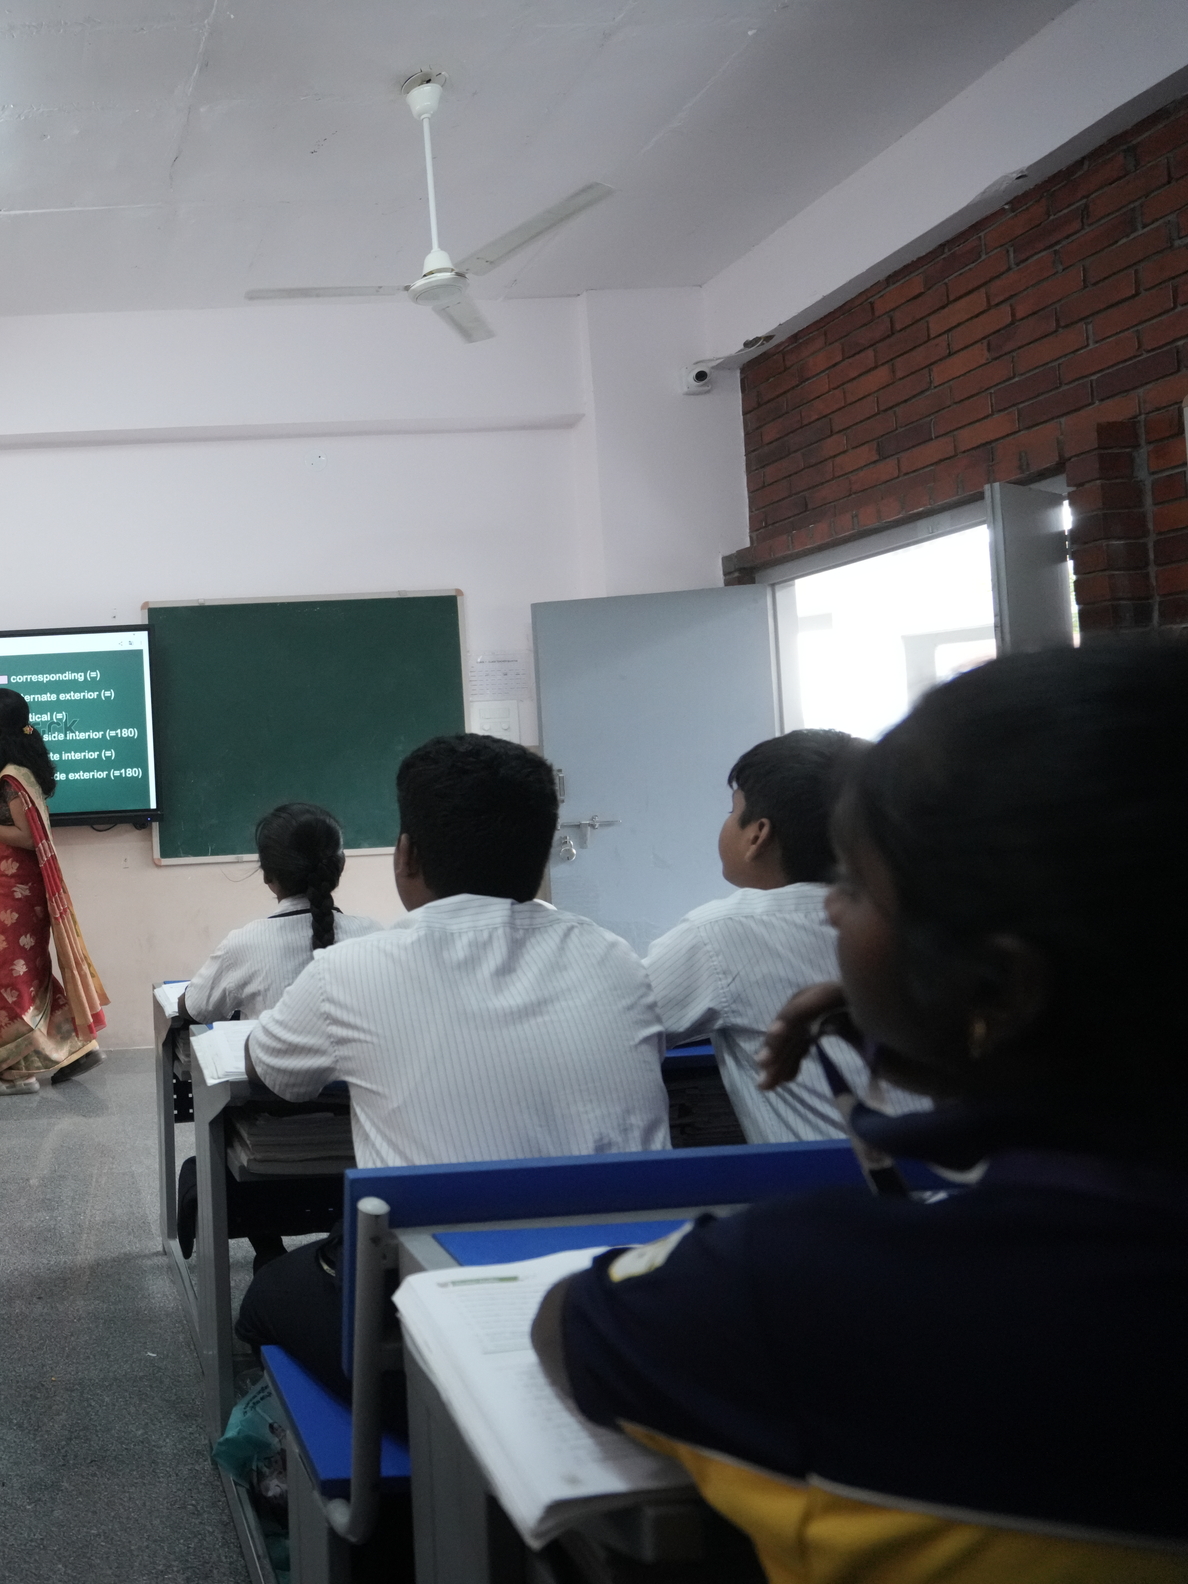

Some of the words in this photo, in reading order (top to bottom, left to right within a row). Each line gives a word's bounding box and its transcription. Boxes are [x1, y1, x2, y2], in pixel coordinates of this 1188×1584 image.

[10, 671, 85, 683] corresponding
[86, 670, 101, 681] (=)
[21, 692, 57, 702] ernate
[59, 690, 99, 701] exterior
[101, 689, 115, 700] (=)
[28, 712, 51, 722] tical
[52, 711, 67, 722] (=)
[42, 731, 65, 741] side
[66, 730, 104, 740] interior
[106, 728, 138, 740] (=180)
[61, 750, 100, 760] interior
[101, 749, 116, 760] (=)
[68, 770, 108, 780] exterior
[110, 768, 143, 780] (=180)
